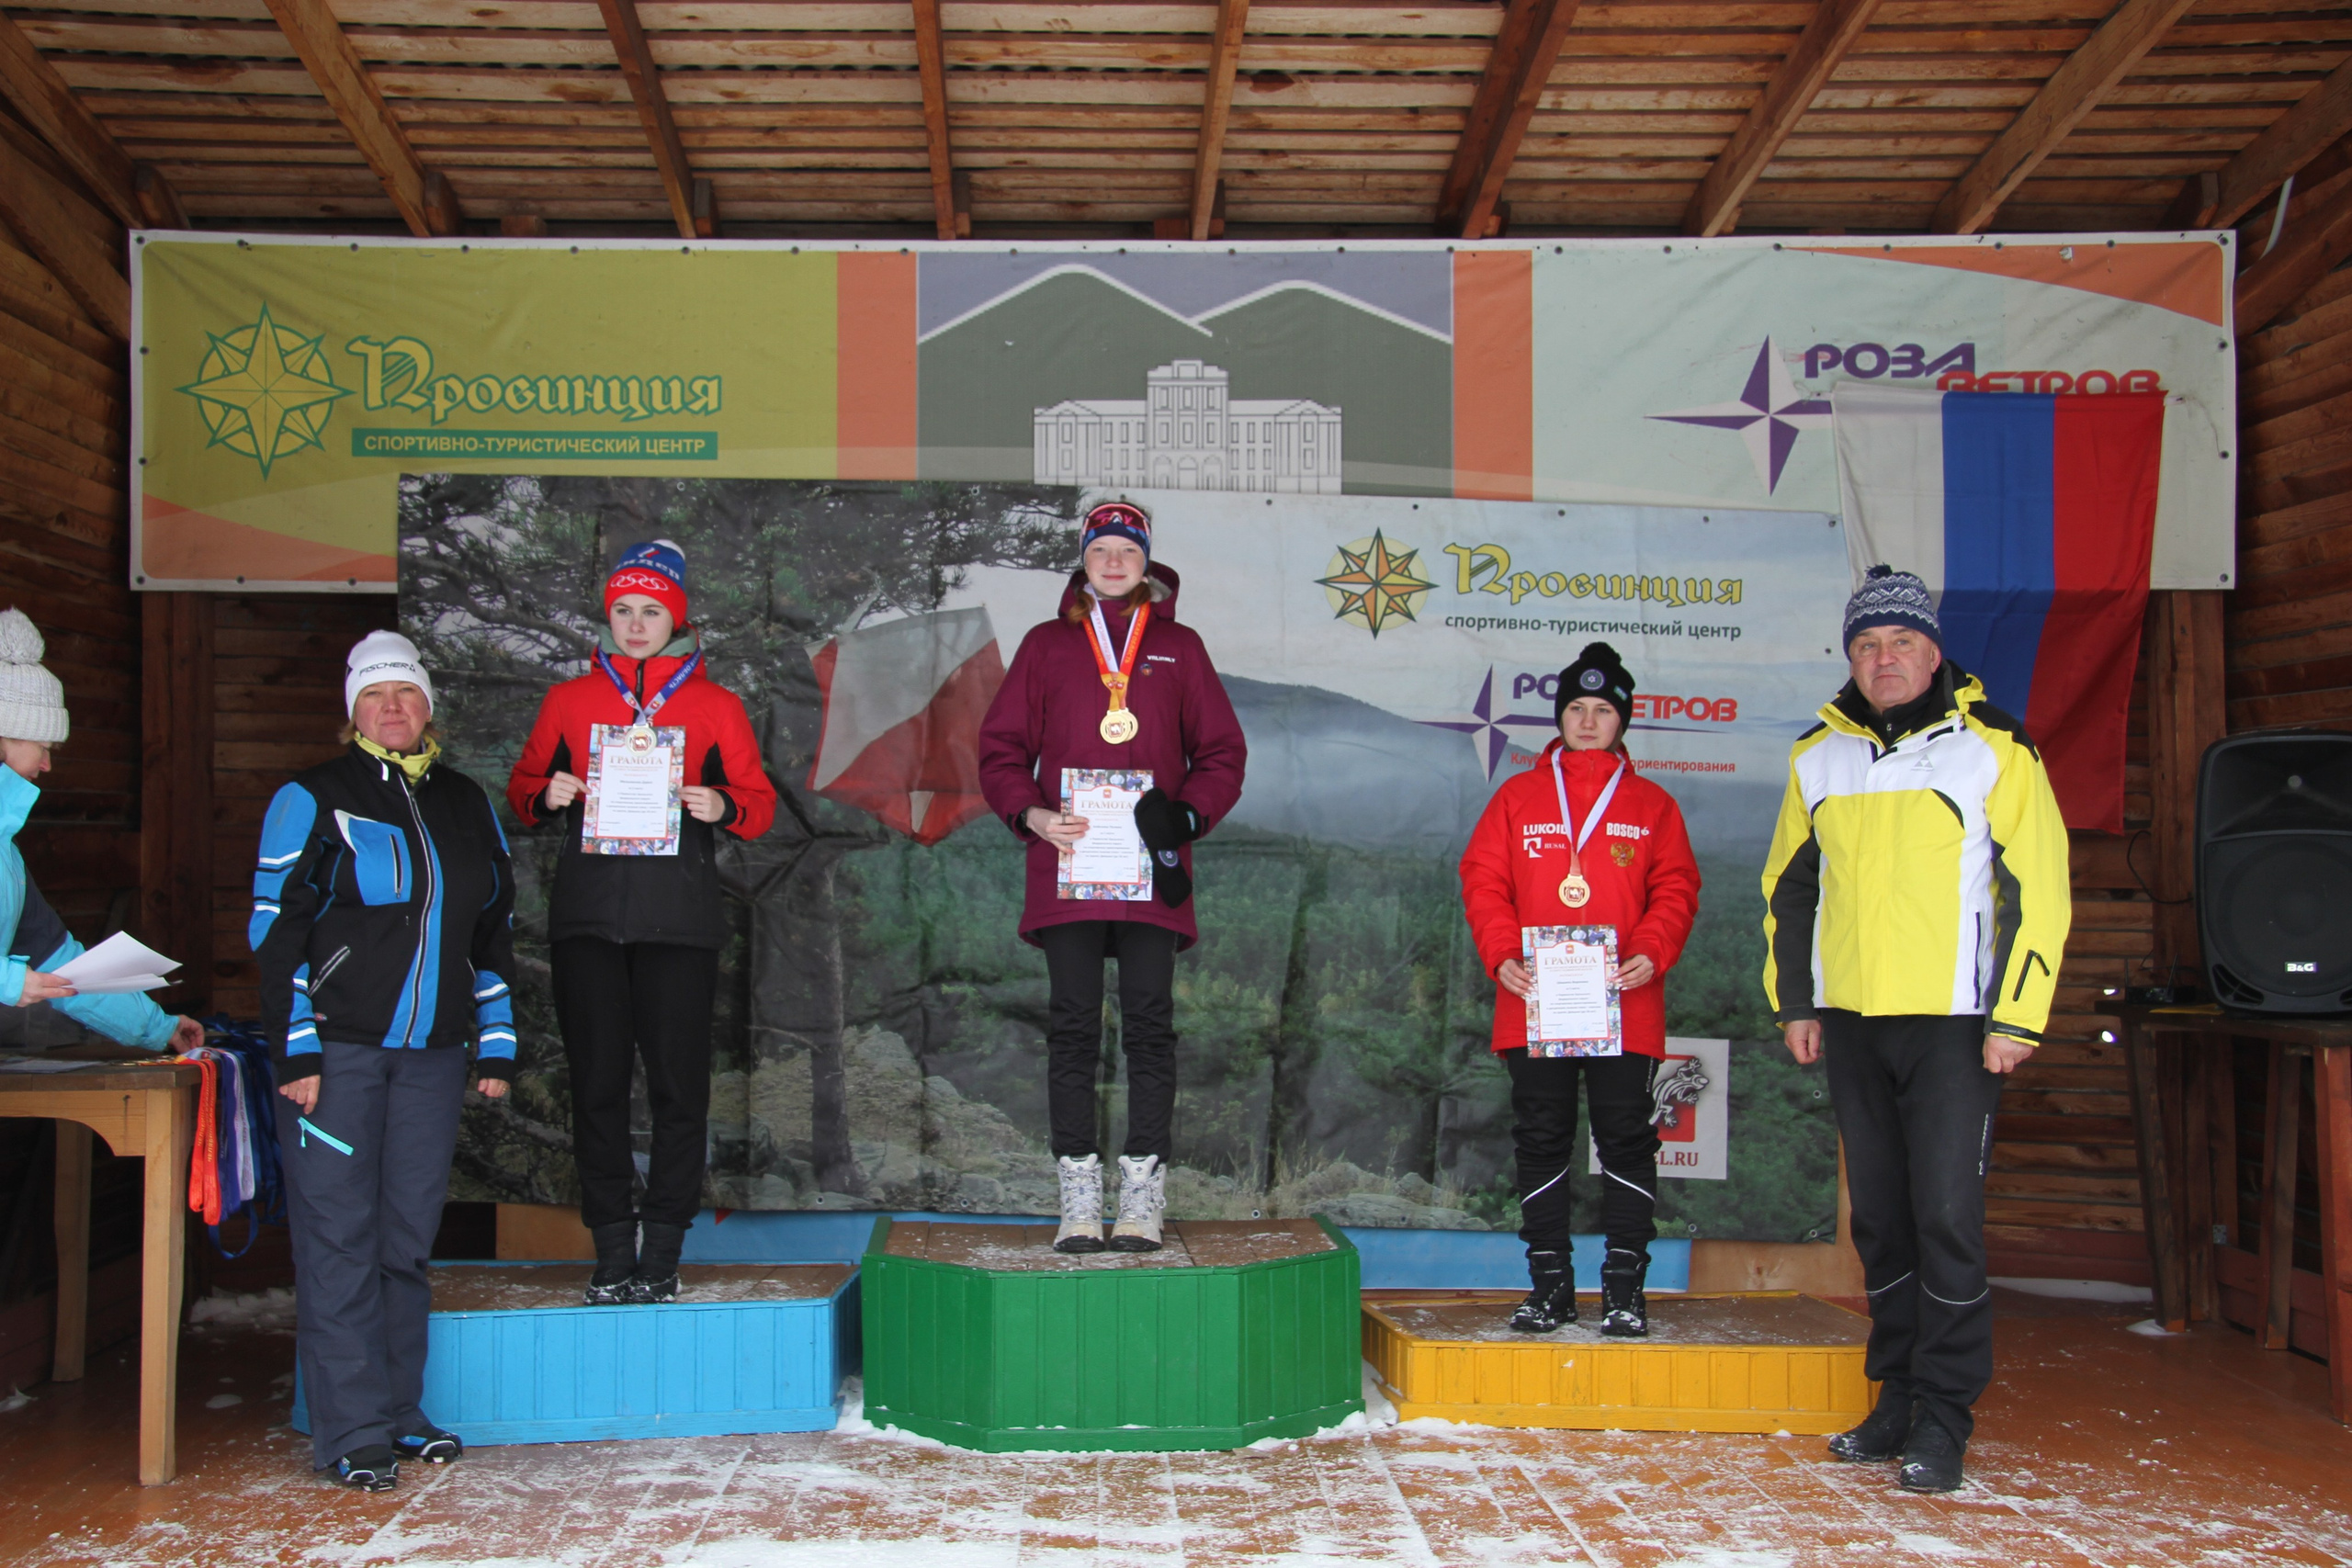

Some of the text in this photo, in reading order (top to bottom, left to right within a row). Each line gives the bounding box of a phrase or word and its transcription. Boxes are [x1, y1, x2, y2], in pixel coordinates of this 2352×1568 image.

[1804, 343, 1975, 378] РОЗА
[345, 335, 723, 425] Провинция
[364, 434, 707, 455] СПОРТИВНО-ТУРИСТИЧЕСКИЙ ЦЕНТР
[1442, 542, 1743, 607] Провинция
[1444, 615, 1742, 641] спортивно-туристический центр
[359, 661, 410, 677] FISCHER
[1513, 672, 1559, 701] РО
[1632, 694, 1737, 723] ЕТРОВ
[610, 755, 663, 765] ГРАМОТА
[1080, 800, 1133, 809] ГРАМОТА
[1606, 822, 1640, 840] BOSCO
[1544, 955, 1597, 965] ГРАМОТА
[2287, 963, 2314, 972] B&G
